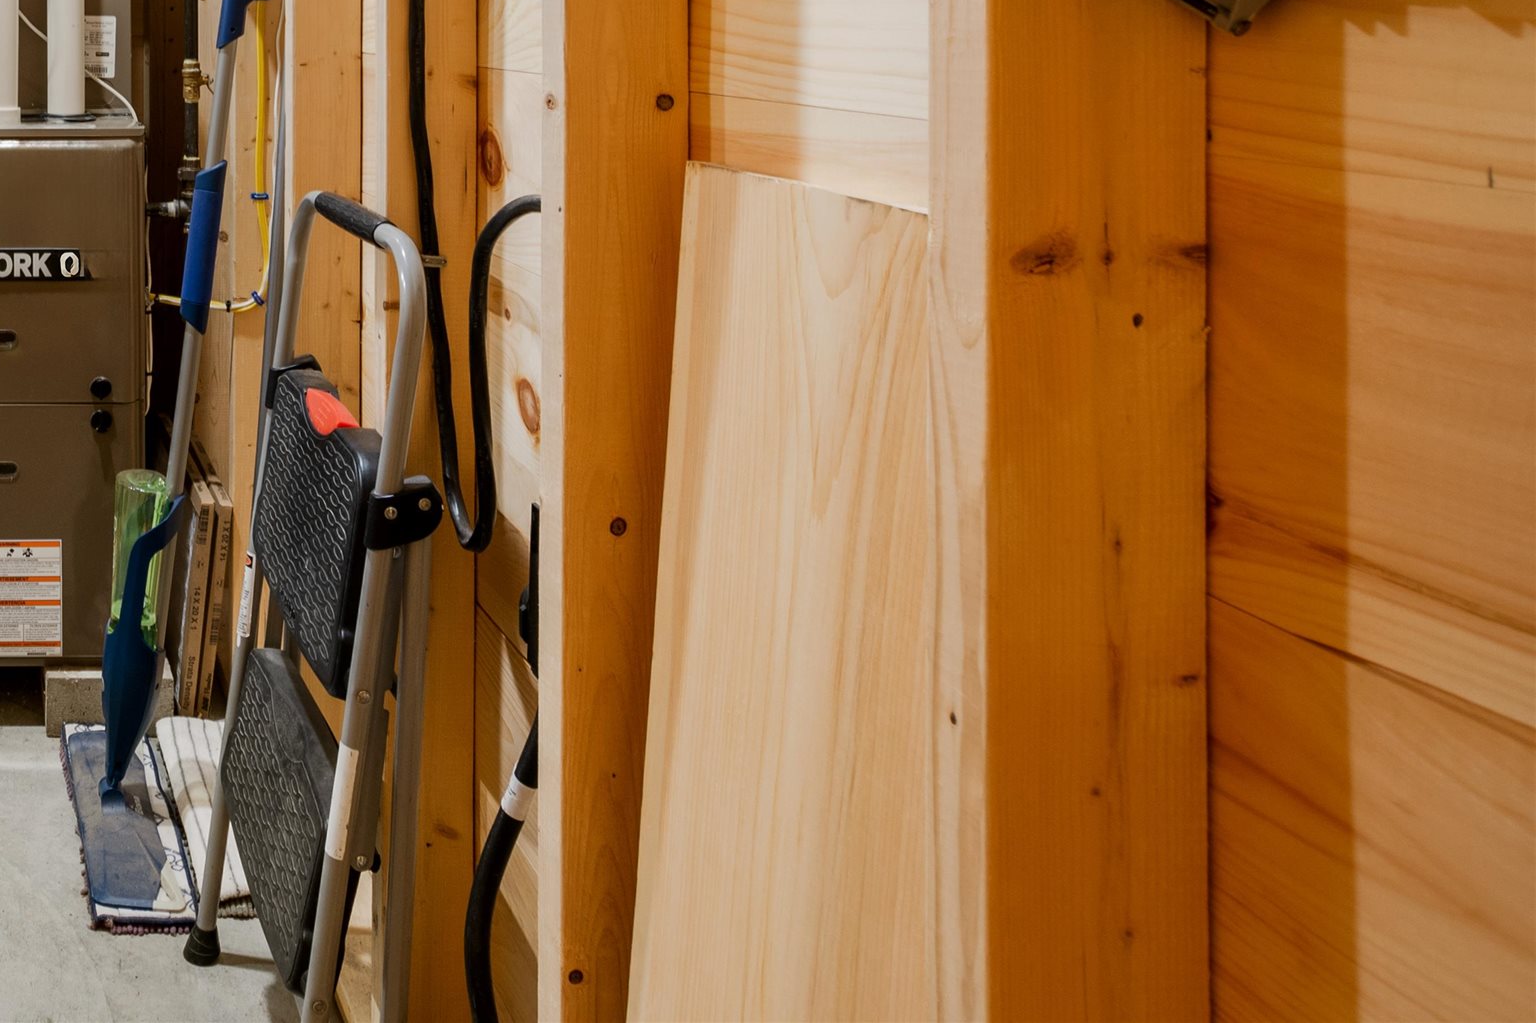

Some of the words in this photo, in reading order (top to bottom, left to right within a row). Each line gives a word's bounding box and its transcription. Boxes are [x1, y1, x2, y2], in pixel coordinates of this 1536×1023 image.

[219, 552, 226, 561] 14
[194, 587, 201, 596] 14
[192, 605, 199, 616] 20
[186, 656, 196, 679] Strata
[182, 681, 193, 711] Density
